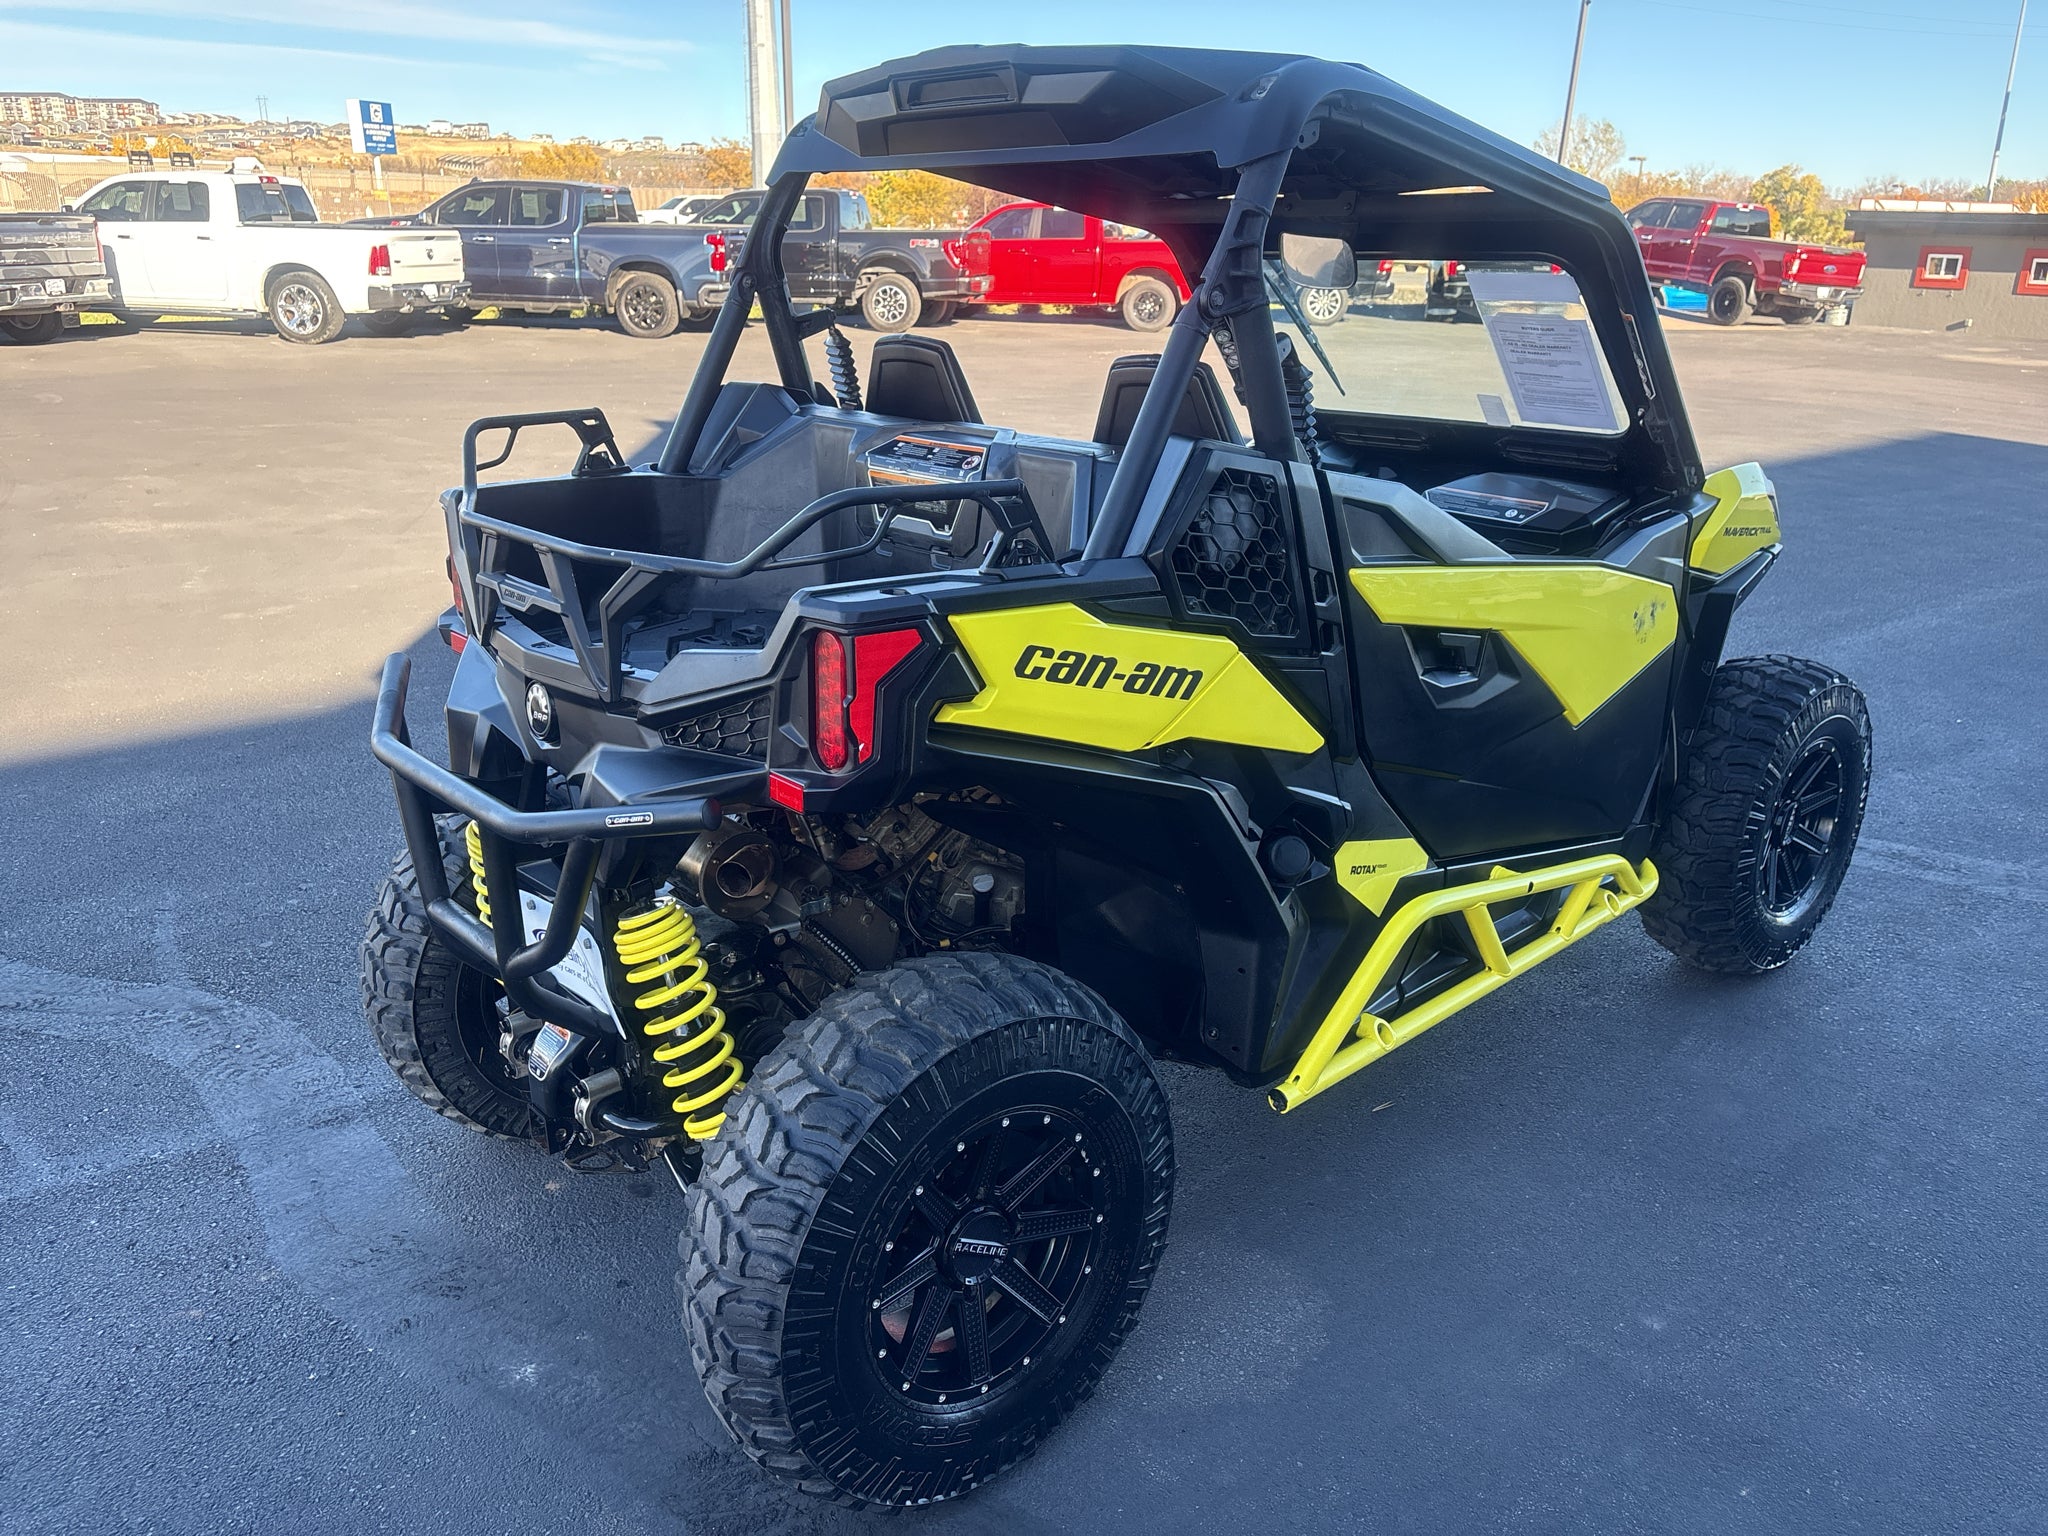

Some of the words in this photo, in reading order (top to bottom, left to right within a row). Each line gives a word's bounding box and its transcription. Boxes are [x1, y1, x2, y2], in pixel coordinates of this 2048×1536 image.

[1723, 527, 1760, 536] MAVERICK
[533, 710, 548, 722] BRP
[1350, 864, 1378, 875] ROTAX
[954, 1242, 1009, 1257] RACELINE
